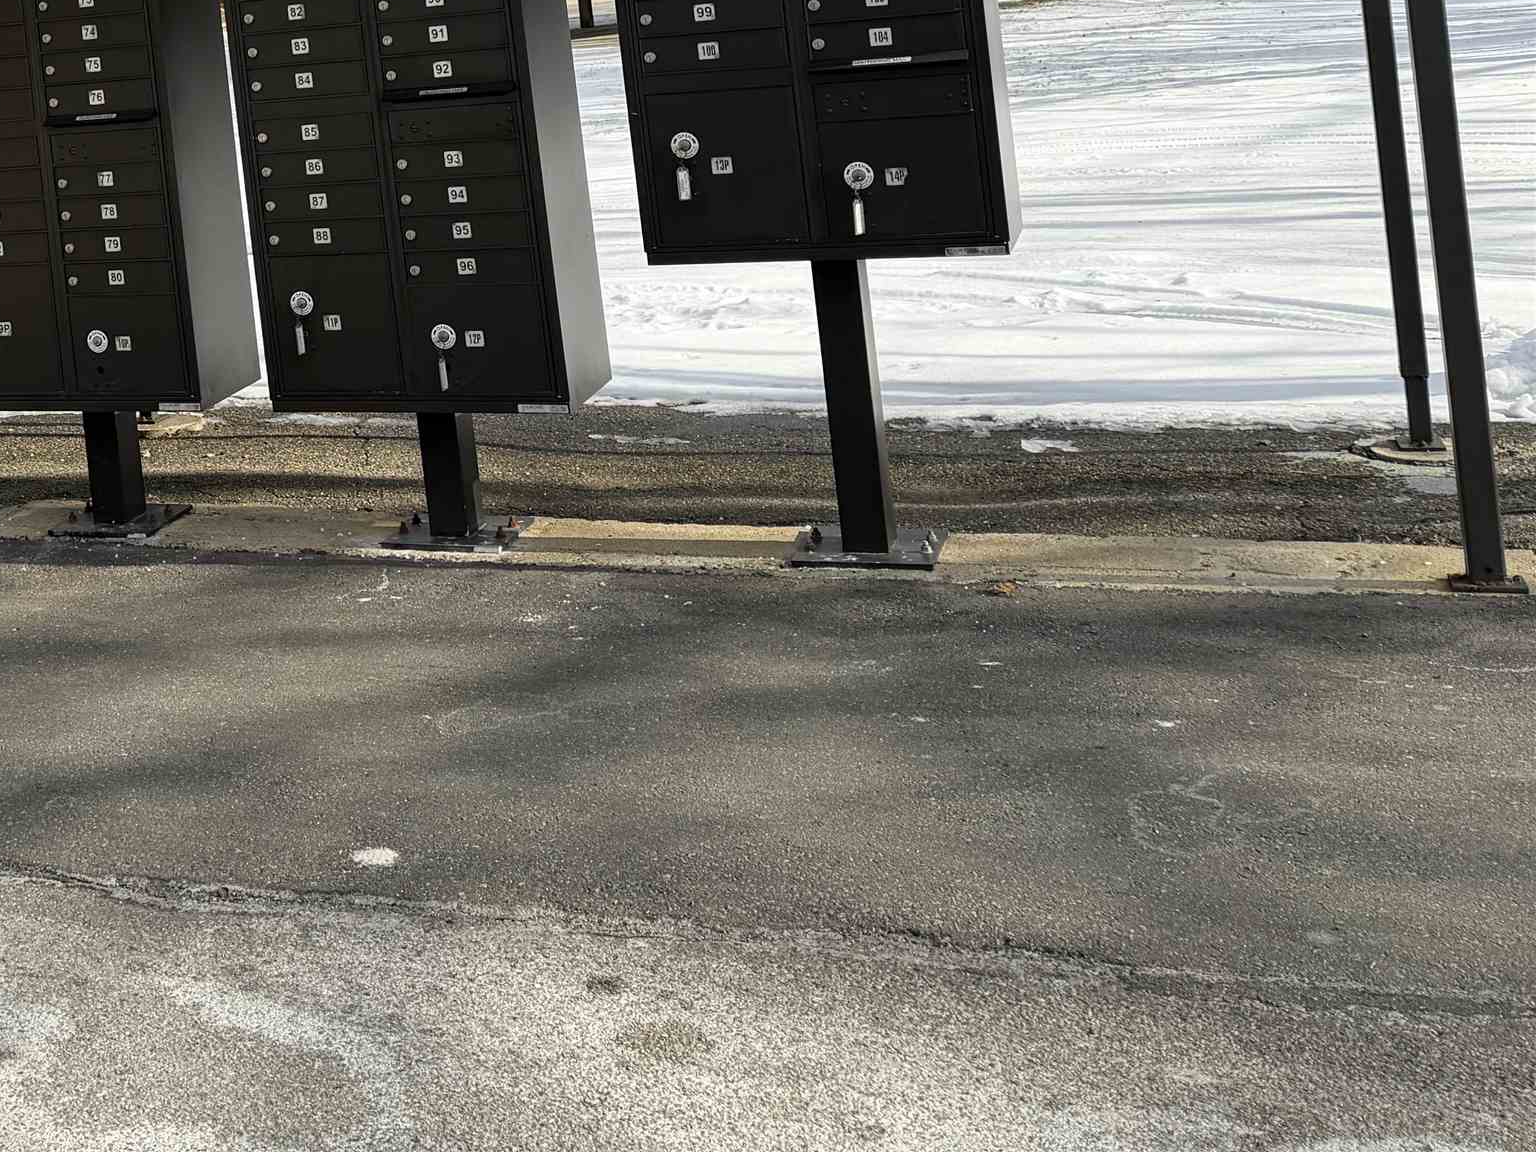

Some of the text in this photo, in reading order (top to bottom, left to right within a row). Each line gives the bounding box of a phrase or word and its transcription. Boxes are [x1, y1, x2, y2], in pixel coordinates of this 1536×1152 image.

[290, 6, 303, 18] 82
[696, 6, 712, 18] 99
[431, 27, 446, 40] 91
[872, 30, 889, 44] 104
[293, 40, 307, 53] 83
[86, 58, 100, 70] 75
[435, 63, 450, 76] 92
[297, 74, 311, 86] 84
[90, 92, 104, 104] 76
[303, 126, 317, 138] 85
[446, 153, 461, 165] 93
[308, 161, 321, 173] 86
[714, 159, 730, 172] 13P
[100, 172, 112, 184] 77
[450, 188, 465, 201] 94
[311, 195, 325, 207] 87
[315, 230, 329, 242] 88
[454, 224, 470, 236] 95
[106, 239, 119, 250] 79
[459, 260, 474, 272] 96
[110, 272, 122, 284] 80
